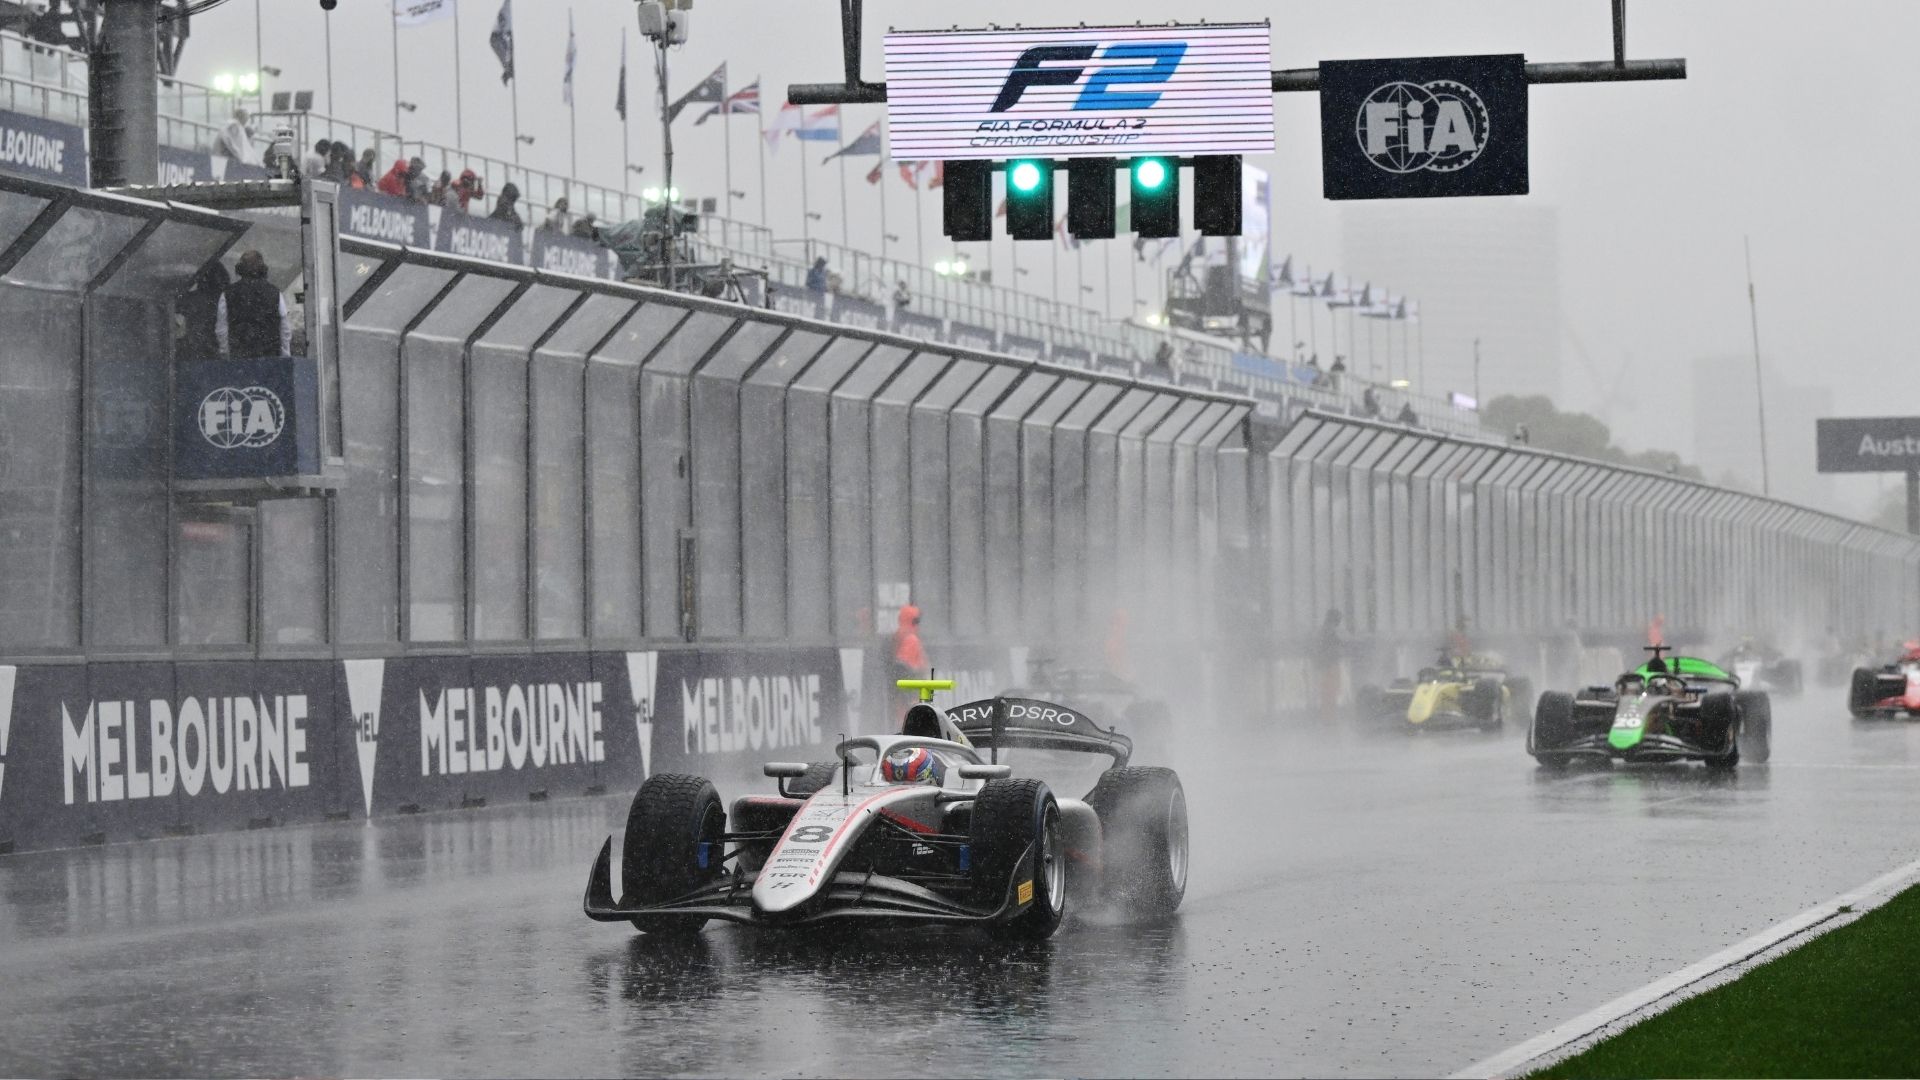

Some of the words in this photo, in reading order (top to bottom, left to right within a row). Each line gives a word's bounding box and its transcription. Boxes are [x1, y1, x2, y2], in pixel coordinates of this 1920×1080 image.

[988, 42, 1188, 113] F2
[969, 134, 1140, 147] CHAMPIONSHIP
[976, 120, 1011, 132] FIA
[1014, 119, 1127, 132] FORMULA
[1132, 118, 1147, 129] 2
[350, 204, 415, 244] MELBOURNE
[419, 681, 605, 776] MELBOURNE
[682, 674, 822, 754] MELBOURNE
[61, 694, 310, 804] MELBOURNE
[788, 825, 834, 843] 8
